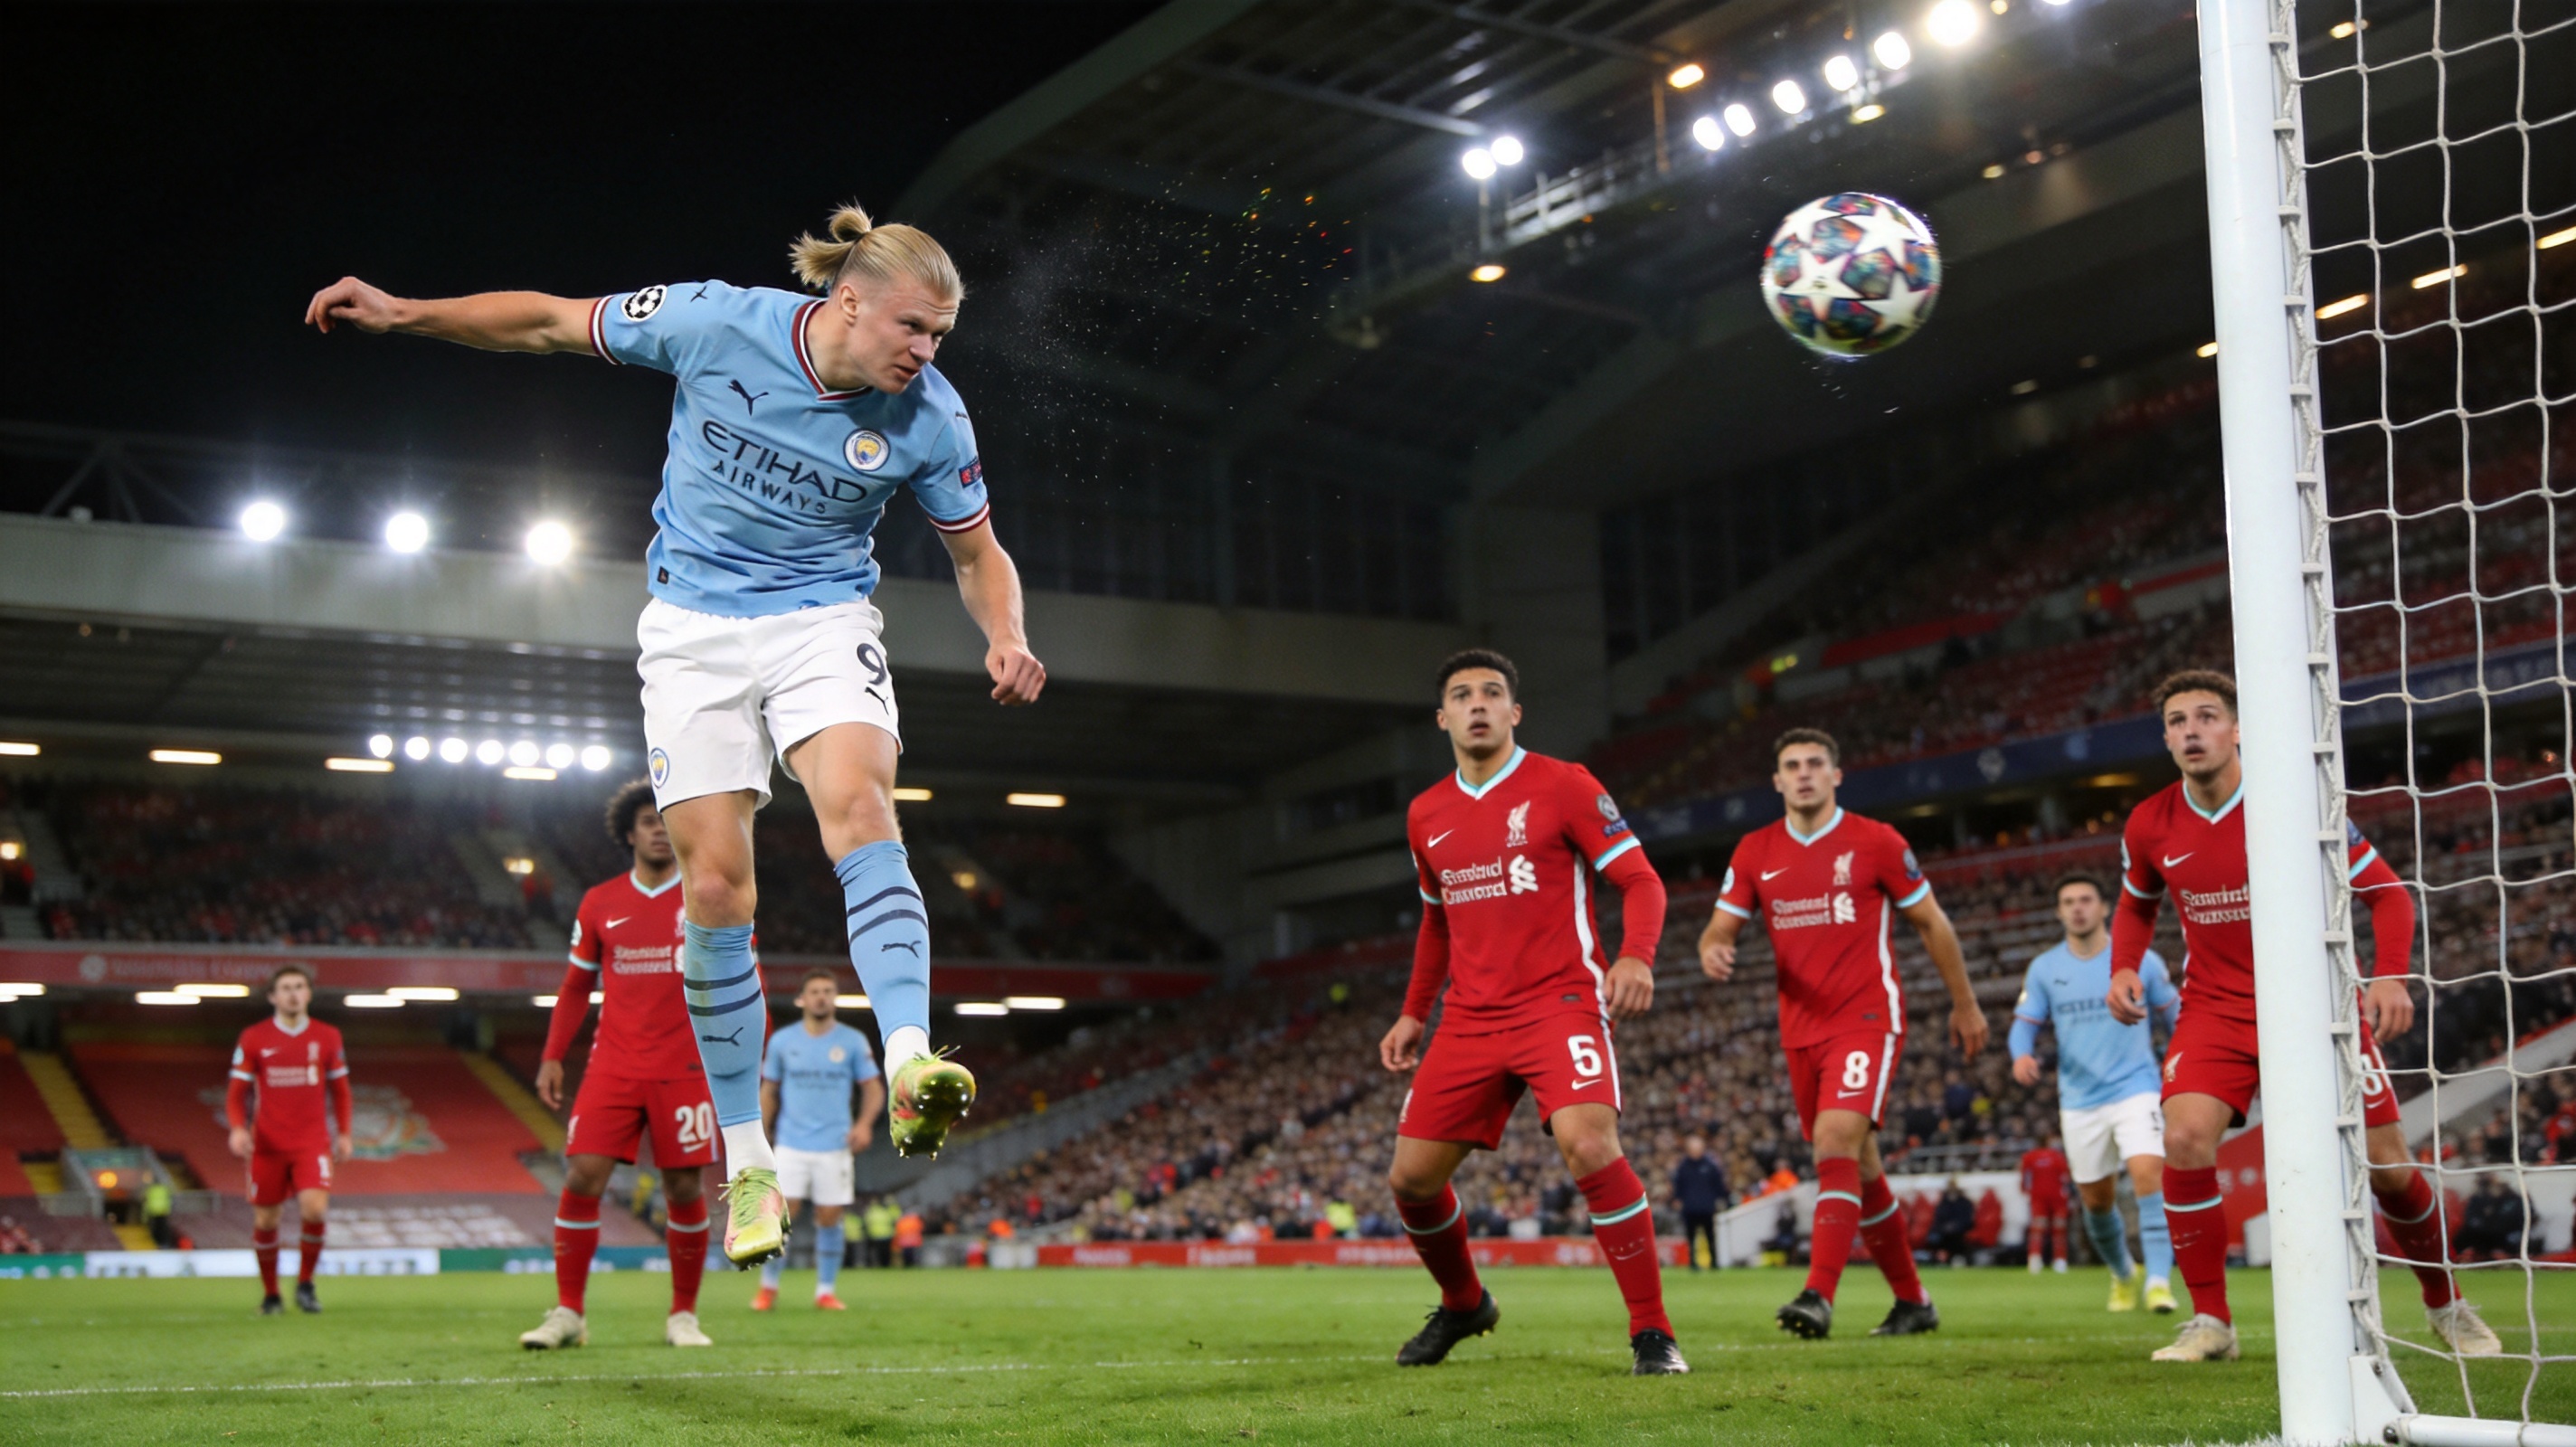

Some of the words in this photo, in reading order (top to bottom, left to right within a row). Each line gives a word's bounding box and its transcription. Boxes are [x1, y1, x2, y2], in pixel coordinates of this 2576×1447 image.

[703, 421, 867, 503] ETIHAD
[712, 459, 827, 515] AIRWAYS
[857, 642, 887, 686] 9
[1567, 1035, 1603, 1076] 5
[1842, 1051, 1870, 1089] 8
[676, 1102, 713, 1143] 20
